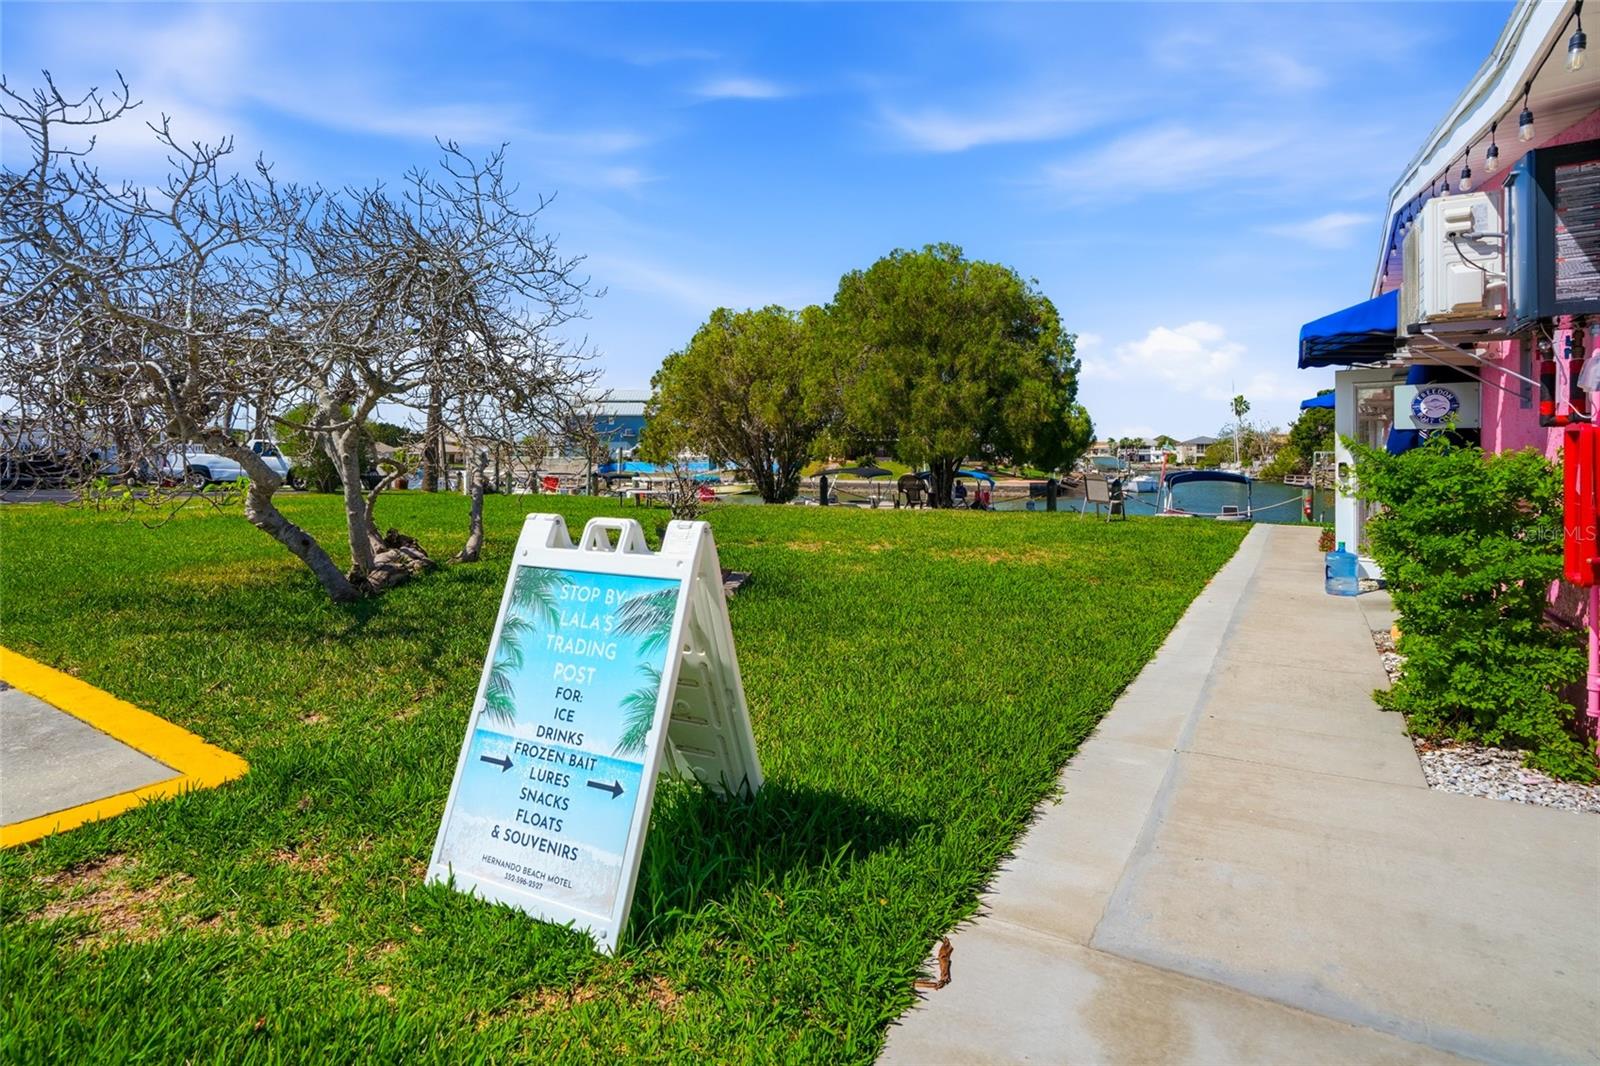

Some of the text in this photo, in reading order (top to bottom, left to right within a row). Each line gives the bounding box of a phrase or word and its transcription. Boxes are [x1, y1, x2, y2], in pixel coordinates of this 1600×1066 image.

[560, 584, 626, 606] STOP BY
[560, 610, 614, 632] LALA'S
[546, 634, 616, 660] TRADING
[553, 663, 596, 684] POST
[555, 687, 583, 703] FOR:
[554, 707, 575, 723] ICE
[536, 725, 584, 745] DRINKS
[514, 742, 598, 772] FROZEN BAIT
[529, 767, 570, 788] LURES
[519, 788, 570, 811] SNACKS
[515, 809, 563, 833] FLOATS
[491, 825, 579, 861] & SOUVENIRS
[482, 854, 573, 889] HERNANDO BEACH MOTEL
